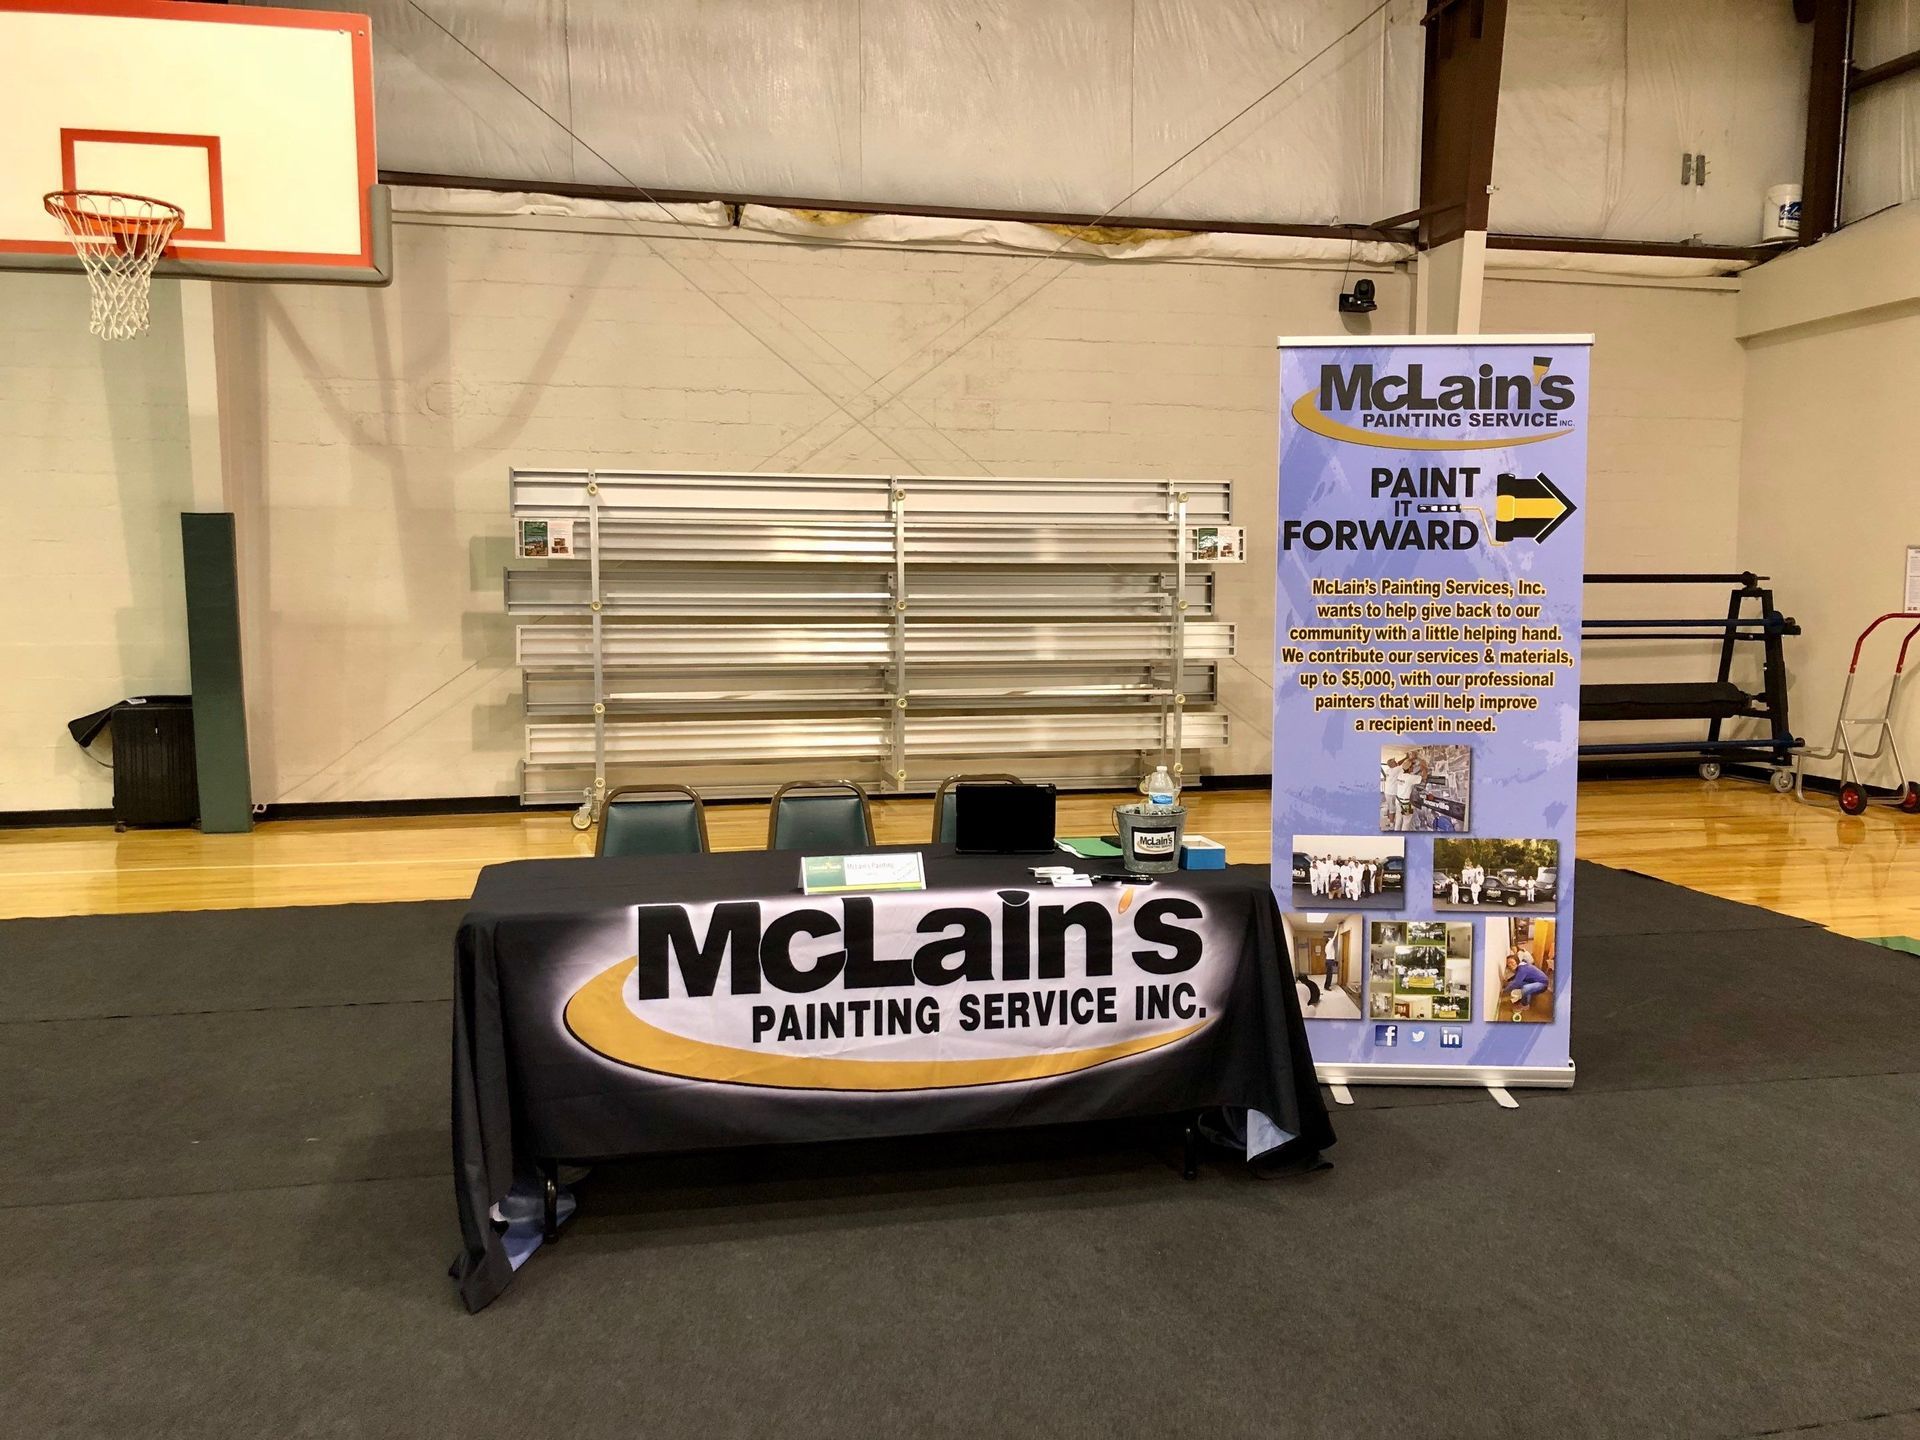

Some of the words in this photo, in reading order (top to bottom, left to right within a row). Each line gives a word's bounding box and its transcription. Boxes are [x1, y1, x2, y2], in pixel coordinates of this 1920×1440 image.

[1320, 357, 1575, 411] McLain's
[1363, 412, 1461, 427] PAINTING
[1469, 412, 1557, 427] SERVICE
[1371, 468, 1480, 498] PAINT
[1395, 500, 1412, 517] IT
[1284, 520, 1479, 551] FORWARD
[1313, 580, 1376, 595] McLain's
[1382, 580, 1440, 598] Painting
[1446, 580, 1513, 597] Services,
[1518, 580, 1545, 595] Inc.
[1317, 604, 1361, 618] wants
[1366, 604, 1381, 618] to
[1386, 603, 1416, 620] help
[1421, 603, 1451, 621] give
[1456, 603, 1492, 618] back
[1497, 604, 1511, 618] to
[1515, 607, 1540, 618] our
[1290, 626, 1370, 643] community
[1375, 626, 1407, 640] with
[1412, 629, 1420, 640] a
[1425, 626, 1459, 640] little
[1464, 626, 1516, 643] helping
[1521, 626, 1562, 641] hand.
[1282, 649, 1303, 663] We
[1308, 649, 1384, 663] contribute
[1389, 652, 1412, 663] our
[1417, 650, 1478, 664] services
[1484, 650, 1495, 664] &
[1500, 650, 1573, 666] materials,
[1300, 674, 1318, 688] up
[1323, 672, 1337, 686] to
[1342, 671, 1395, 688] $5,000,
[1400, 671, 1431, 686] with
[1436, 675, 1460, 686] our
[1465, 672, 1554, 689] professional
[1315, 695, 1375, 710] painters
[1379, 694, 1409, 708] that
[1413, 694, 1439, 708] will
[1443, 694, 1475, 711] help
[1480, 695, 1537, 711] improve
[1355, 720, 1364, 731] a
[1369, 717, 1434, 734] recipient
[1438, 717, 1451, 731] in
[1456, 717, 1496, 731] need.
[638, 887, 1204, 1001] McLain's
[752, 997, 940, 1043] PAINTING
[959, 986, 1118, 1031] SERVICE
[1135, 982, 1207, 1021] INC.
